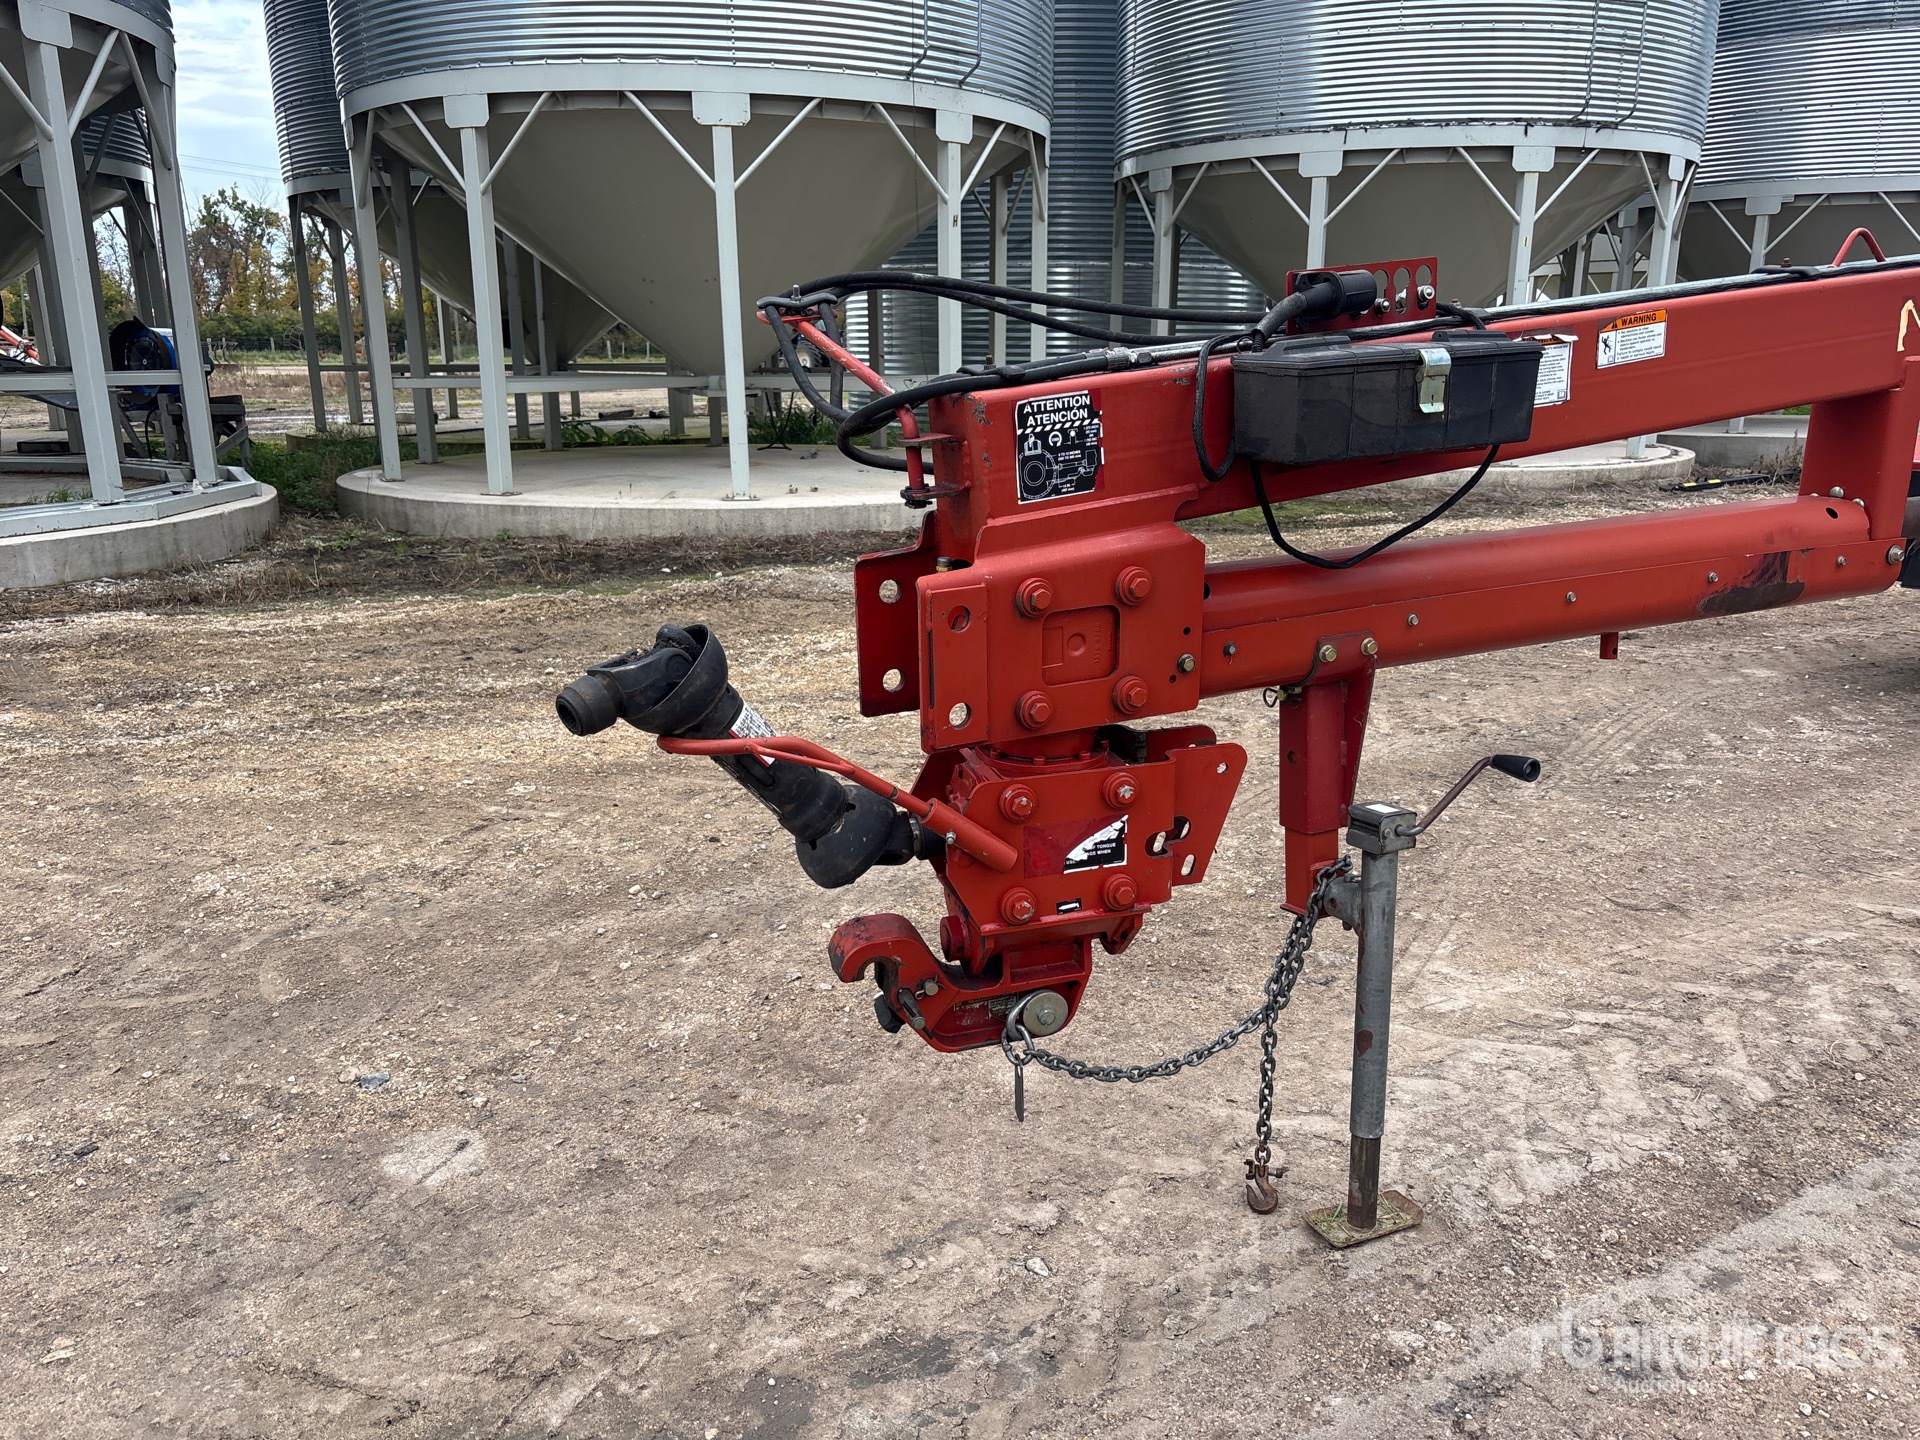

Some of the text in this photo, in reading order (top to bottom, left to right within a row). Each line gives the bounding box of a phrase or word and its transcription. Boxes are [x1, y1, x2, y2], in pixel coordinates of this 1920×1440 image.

[1621, 313, 1657, 327] WARNING
[1023, 395, 1090, 414] ATTENTION
[1027, 407, 1088, 427] ATENCIÓN
